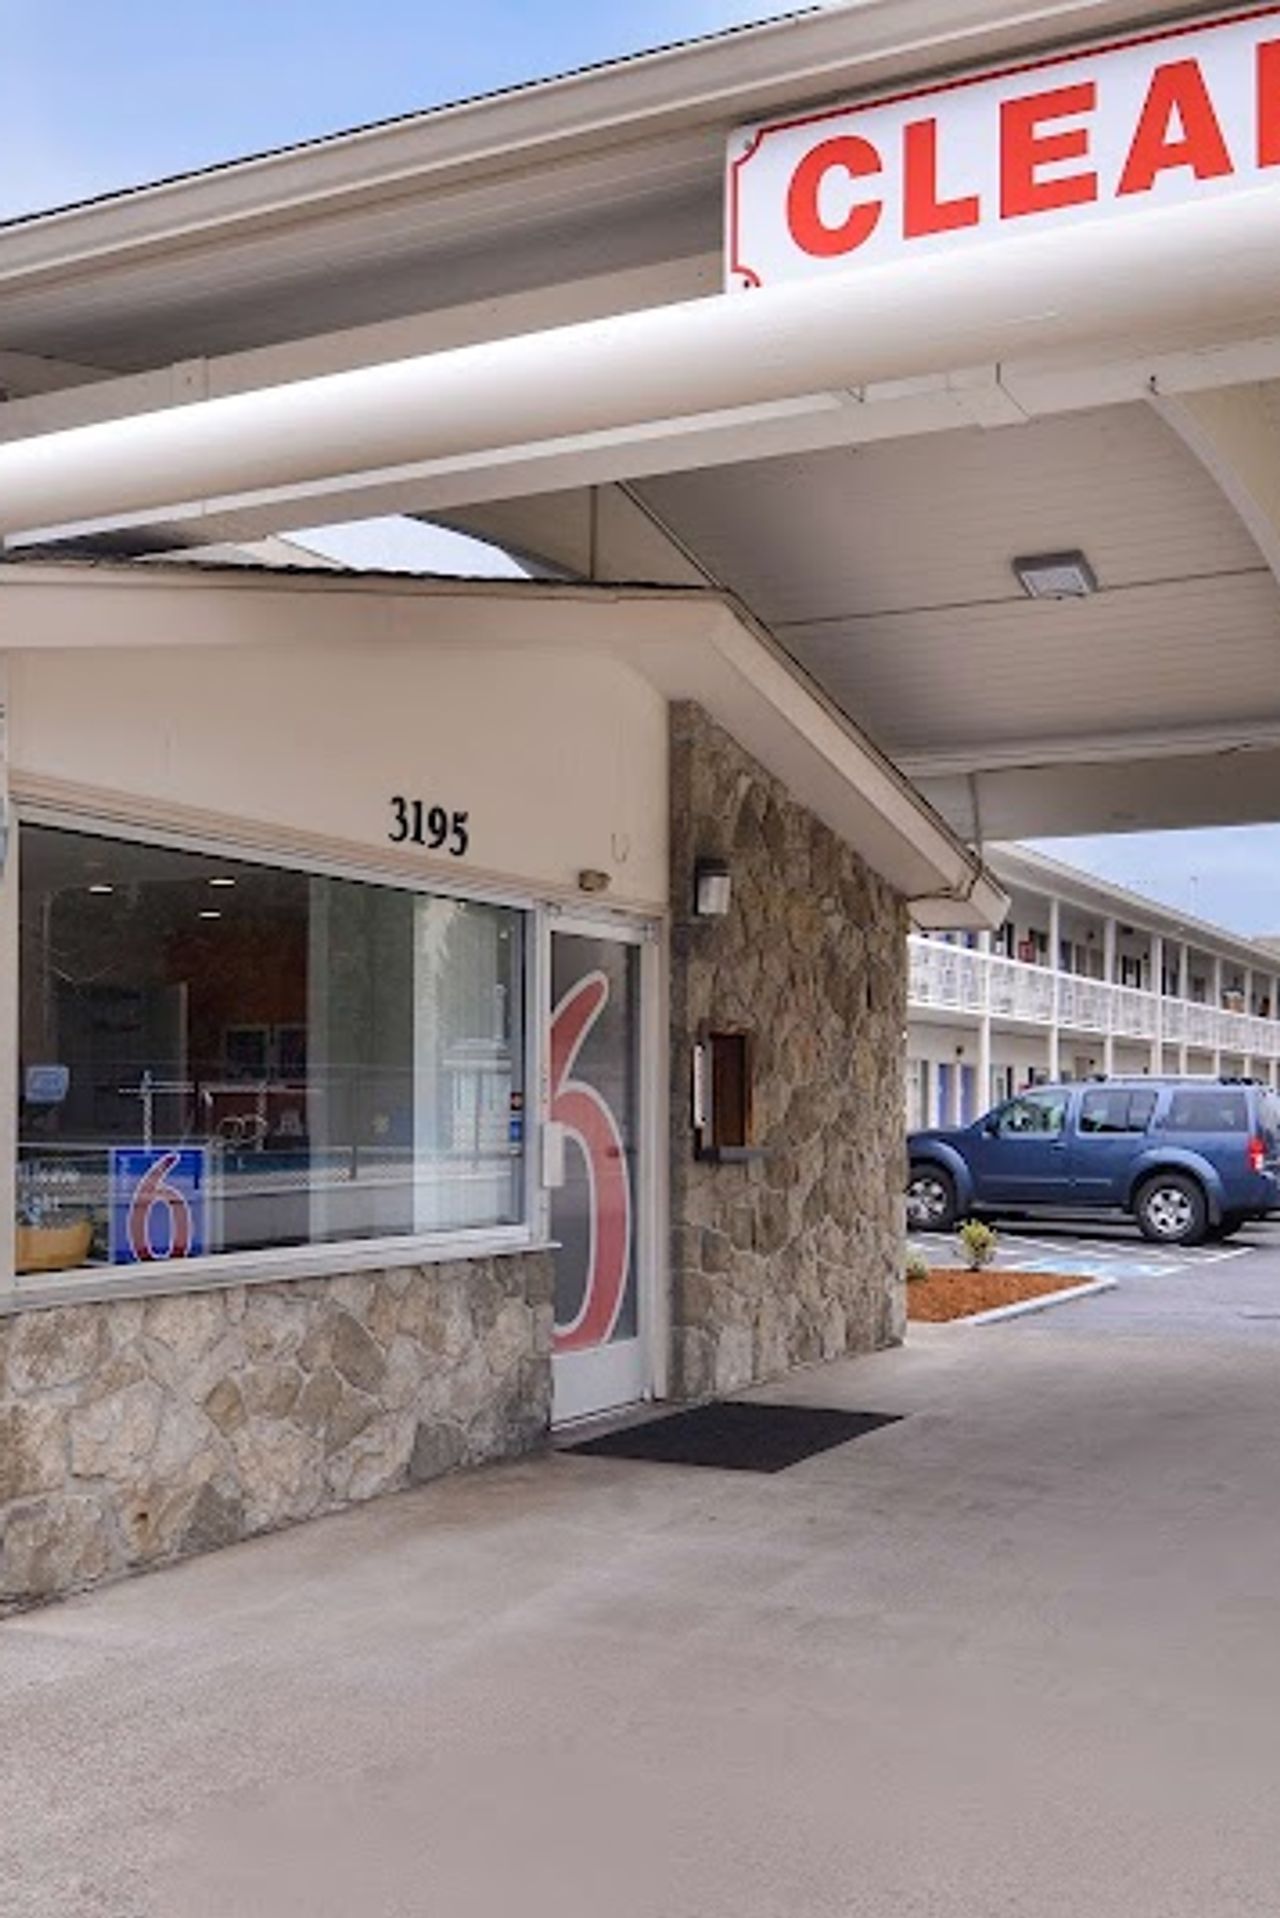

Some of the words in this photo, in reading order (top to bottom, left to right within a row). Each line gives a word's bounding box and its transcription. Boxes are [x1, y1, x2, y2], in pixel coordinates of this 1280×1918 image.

[787, 38, 1280, 258] CLEA
[388, 796, 469, 856] 3195
[126, 1152, 193, 1260] 6
